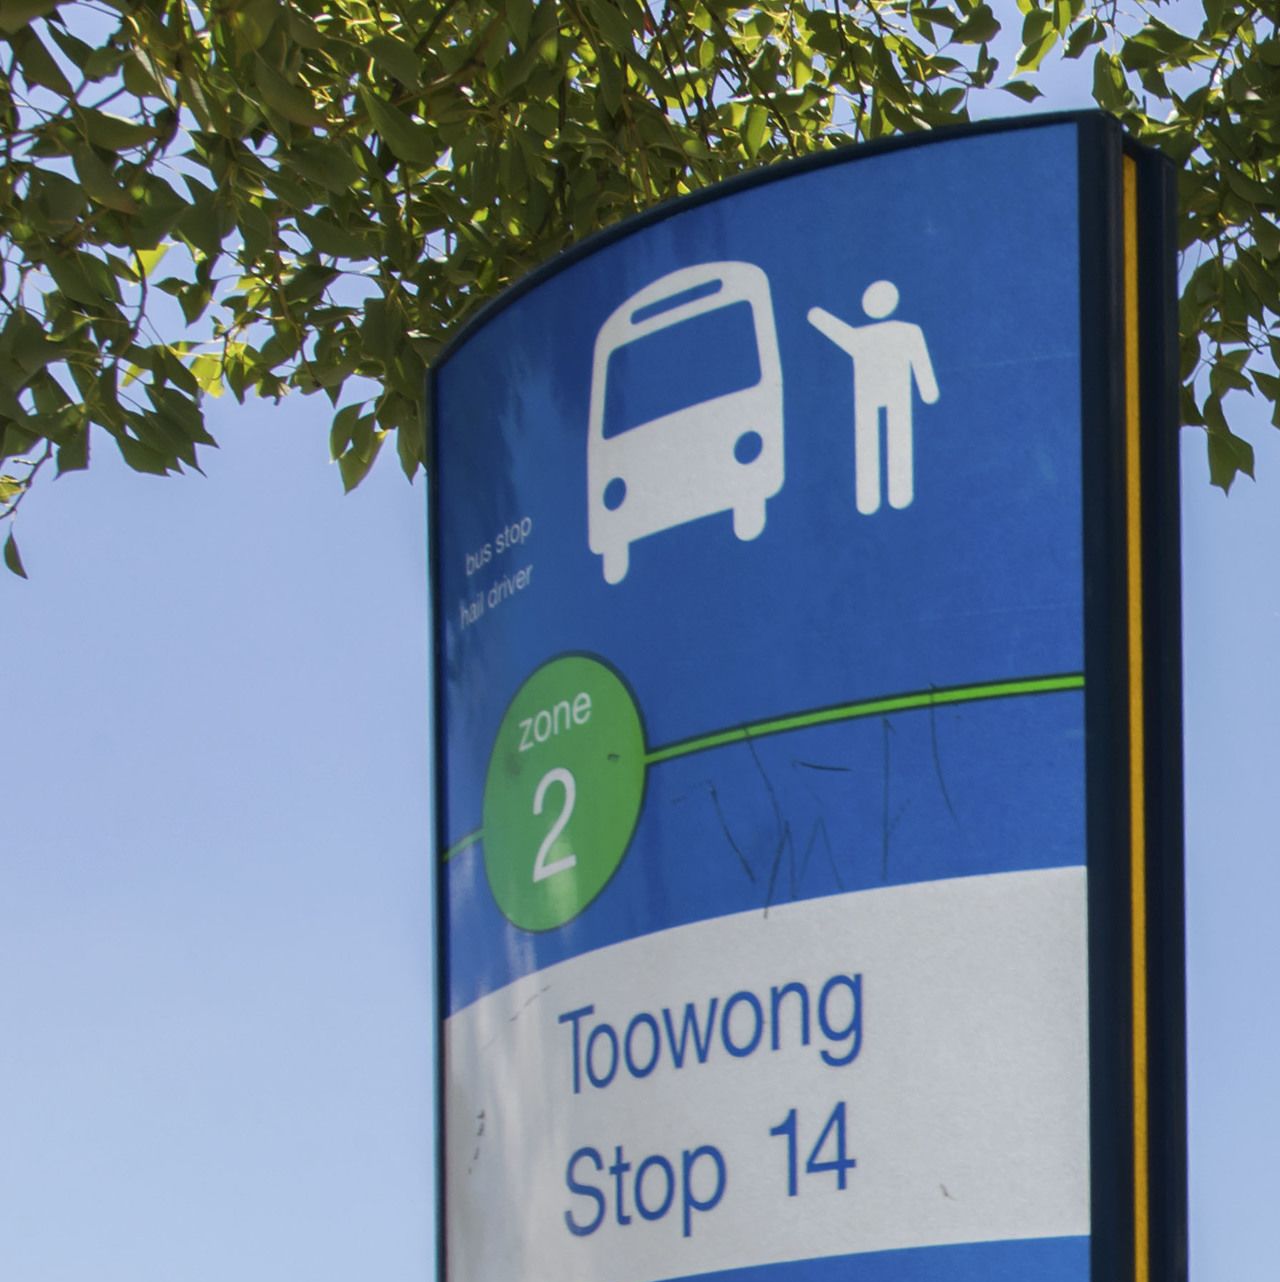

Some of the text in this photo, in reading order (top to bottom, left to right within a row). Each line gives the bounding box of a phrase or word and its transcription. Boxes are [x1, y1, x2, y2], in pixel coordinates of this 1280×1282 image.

[466, 516, 532, 576] bus stop
[460, 564, 533, 630] hail driver
[518, 692, 592, 752] zone
[533, 767, 576, 883] 2
[558, 973, 863, 1094] Toowong
[564, 1101, 857, 1237] Stop 14
